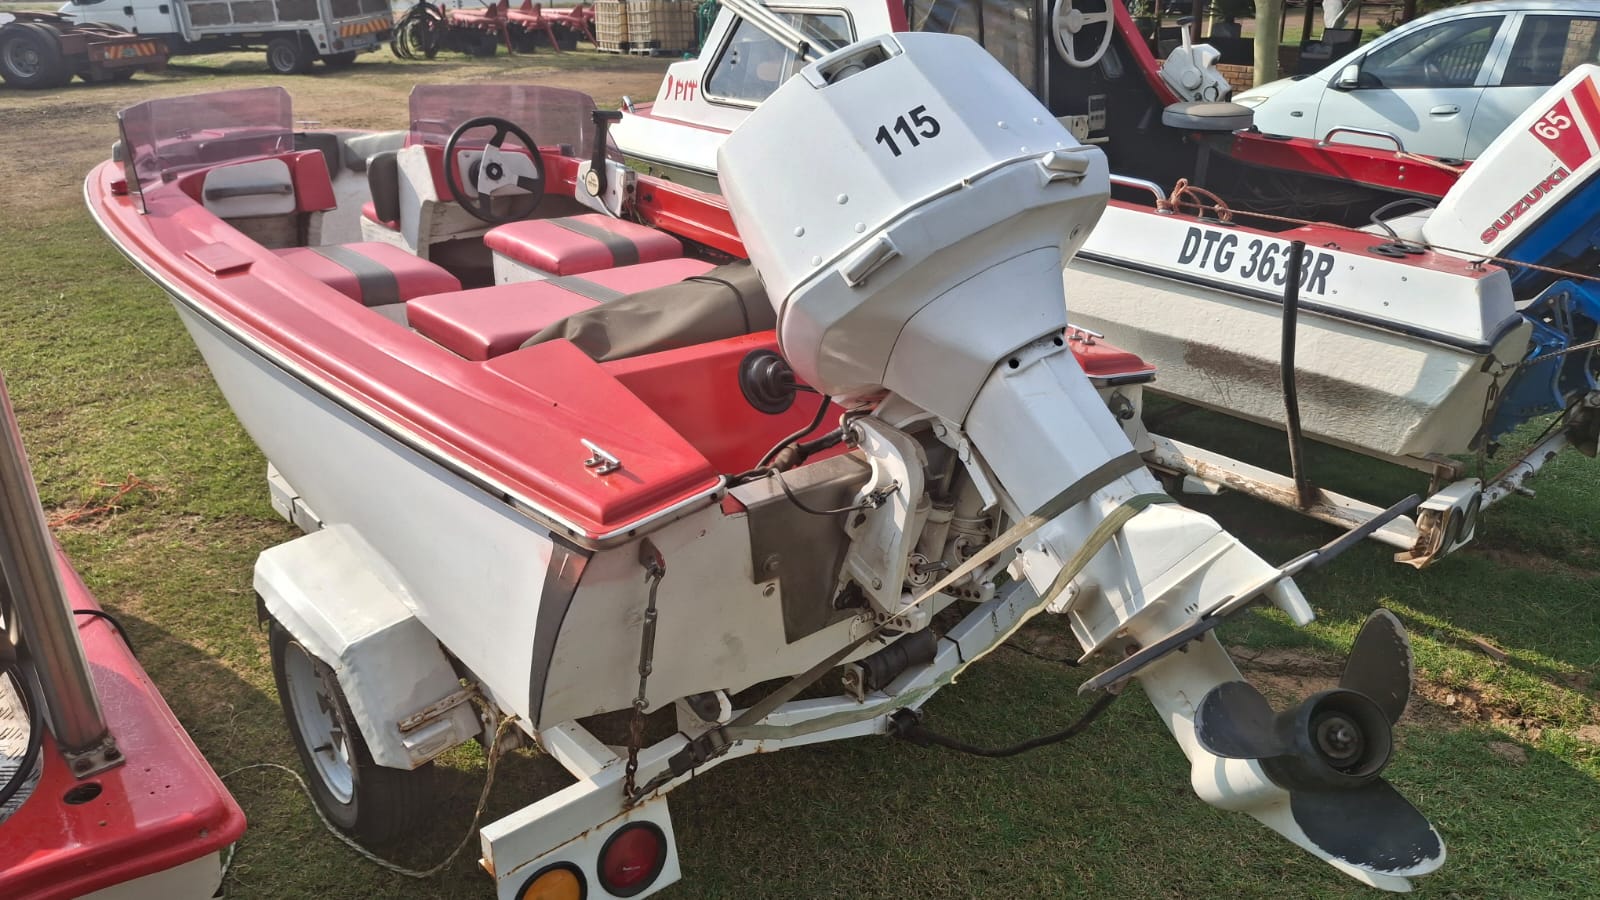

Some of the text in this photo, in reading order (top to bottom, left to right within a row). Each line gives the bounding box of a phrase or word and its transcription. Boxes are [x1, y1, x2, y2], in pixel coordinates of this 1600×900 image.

[875, 104, 941, 157] 115
[1534, 110, 1571, 140] 65
[1480, 166, 1571, 244] SUZUKI
[1177, 226, 1239, 273] DTG
